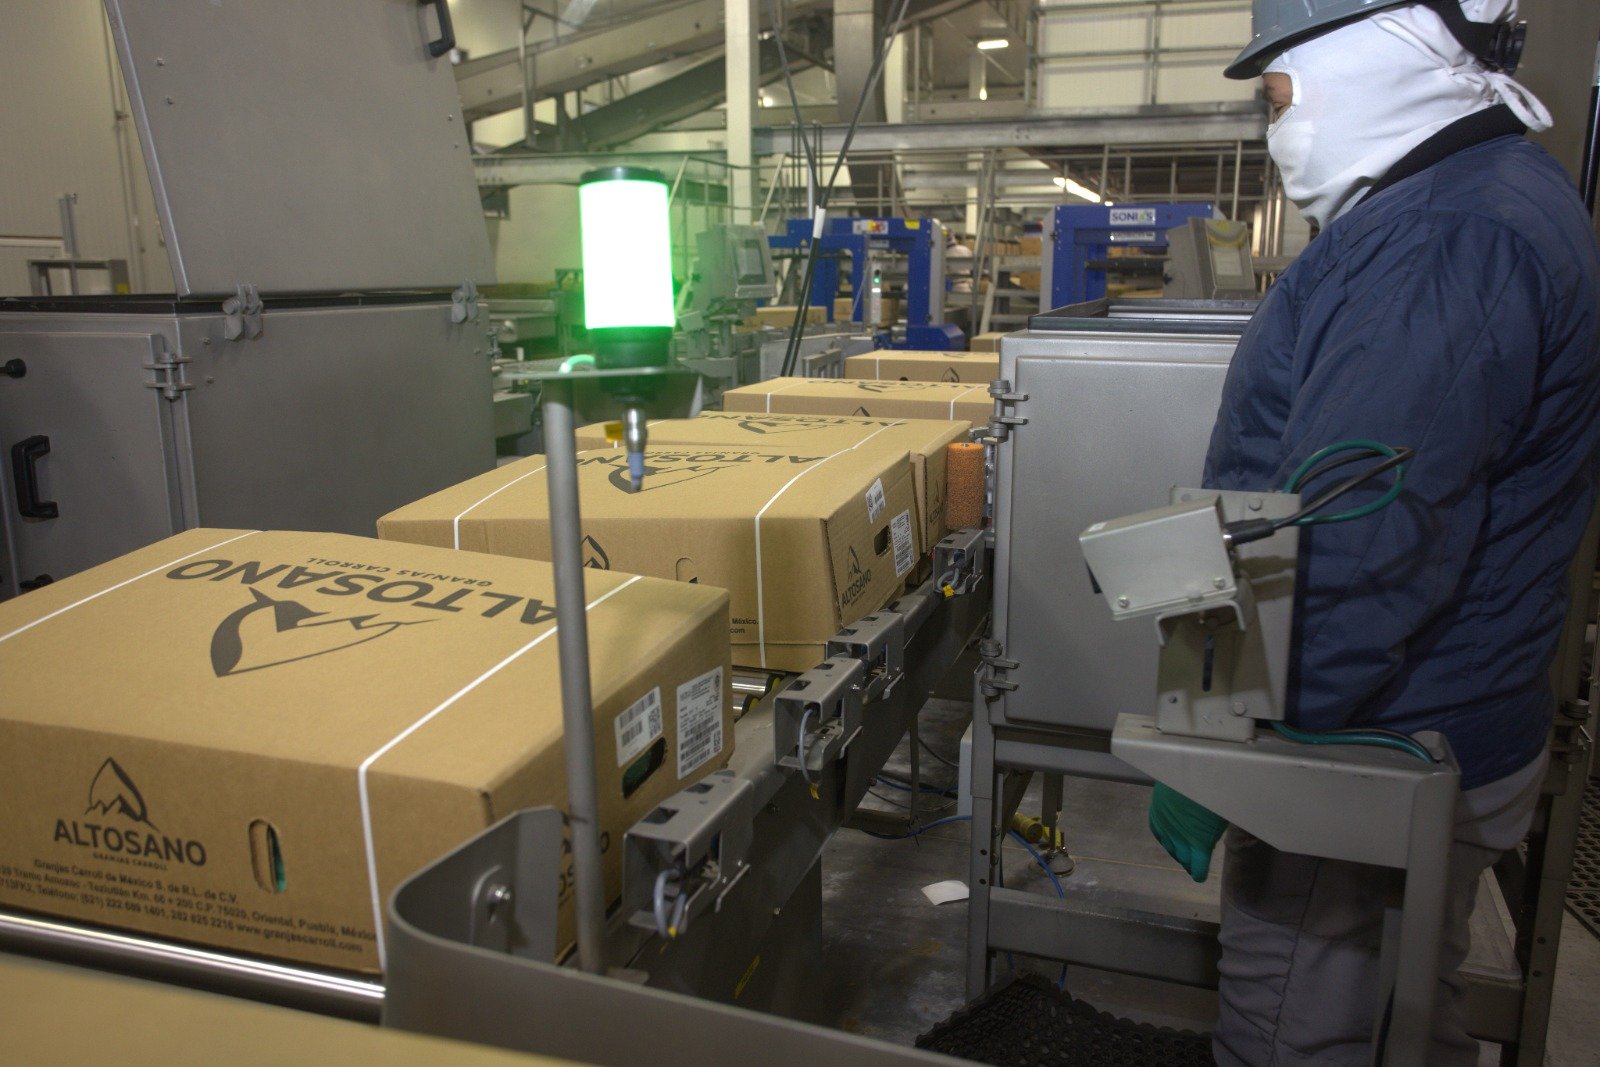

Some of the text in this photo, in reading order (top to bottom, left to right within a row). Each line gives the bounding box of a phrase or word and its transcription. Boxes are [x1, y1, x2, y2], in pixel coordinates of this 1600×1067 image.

[166, 559, 557, 626] ALTOSANO
[307, 556, 493, 587] GRANJAS CARROLL
[54, 819, 207, 867] ALTOSANO
[34, 857, 69, 873] Granjas
[71, 863, 103, 879] Carroll
[105, 870, 116, 882] de
[204, 888, 216, 900] de
